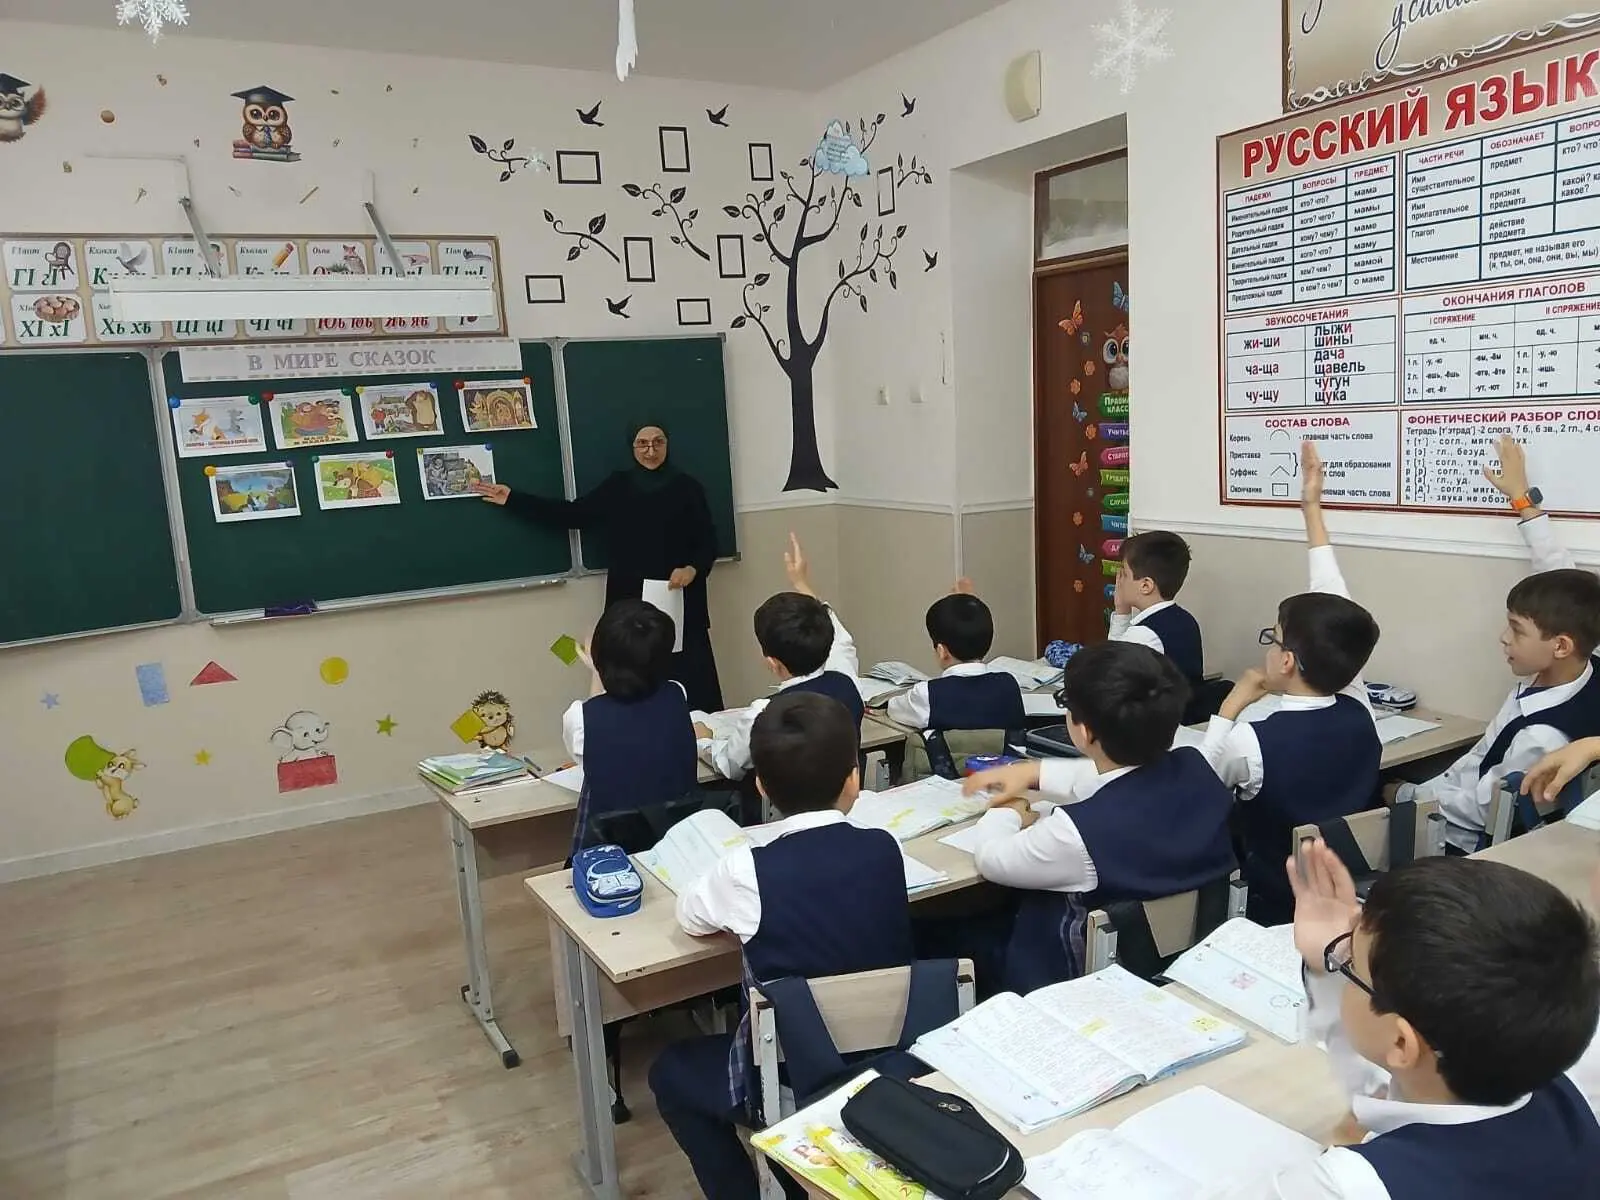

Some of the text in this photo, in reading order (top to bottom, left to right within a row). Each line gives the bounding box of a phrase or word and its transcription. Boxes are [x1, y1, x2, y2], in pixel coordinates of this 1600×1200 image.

[1244, 50, 1600, 178] РУССКИЙ ЯЗЫК
[1490, 132, 1545, 149] ОБОЗНАЧАЕТ
[1563, 143, 1581, 155] кто?
[1419, 149, 1465, 164] ЧАСТИ РЕЧИ
[1490, 156, 1522, 170] предмет
[1354, 165, 1389, 178] ПРЕДМЕТ
[1302, 177, 1337, 190] ВОПРОСЫ
[1412, 175, 1426, 184] Имя
[1412, 175, 1475, 194] существительное
[1563, 172, 1591, 186] какой?
[1354, 186, 1377, 197] мама
[1490, 188, 1521, 200] признак
[1562, 184, 1589, 197] какое?
[1354, 204, 1380, 214] мамы
[1412, 202, 1426, 211] Имя
[1490, 197, 1526, 210] предмета
[1412, 204, 1469, 221] прилагательное
[1354, 223, 1377, 233] маме
[1489, 217, 1525, 231] действие
[1412, 228, 1435, 238] Глагол
[1489, 228, 1526, 240] предмета
[1354, 241, 1377, 250] маму
[1524, 246, 1533, 255] не
[1535, 241, 1570, 253] называя
[1572, 239, 1586, 249] его
[1354, 258, 1383, 268] мамой
[1411, 252, 1459, 265] Местоимение
[1362, 275, 1384, 284] маме
[1443, 282, 1586, 307] ОКОНЧАНИЯ ГЛАГОЛОВ
[1265, 309, 1349, 327] ЗВУКОСОЧЕТАНИЯ
[1434, 313, 1476, 325] СПРЯЖЕНИЕ
[1314, 323, 1352, 336] лыжи
[1244, 337, 1280, 350] жи-ши
[1314, 334, 1353, 347] шины
[247, 349, 437, 370] В МИРЕ СКАЗОК
[1314, 349, 1345, 363] дача
[1246, 363, 1279, 376] ча-ща
[1314, 361, 1365, 377] щавель
[1314, 377, 1350, 392] чугун
[1246, 390, 1280, 404] чу-щу
[1314, 390, 1347, 405] щука
[1265, 417, 1350, 428] СОСТАВ СЛОВА
[1408, 411, 1506, 424] ФОНЕТИЧЕСКИЙ
[1511, 411, 1563, 422] РАЗБОР
[1351, 432, 1373, 440] слова
[1407, 427, 1437, 435] Тетрадь
[1516, 425, 1520, 433] 7
[1535, 424, 1541, 433] 6
[1560, 424, 1566, 432] 2
[1585, 424, 1591, 432] 4
[1230, 433, 1251, 443] Корень
[1230, 451, 1261, 460] Приставка
[1457, 448, 1488, 457] безуд.
[1345, 460, 1391, 470] образования
[1230, 468, 1258, 477] Суффикс
[1230, 485, 1262, 494] Окончание
[1437, 495, 1462, 503] звука
